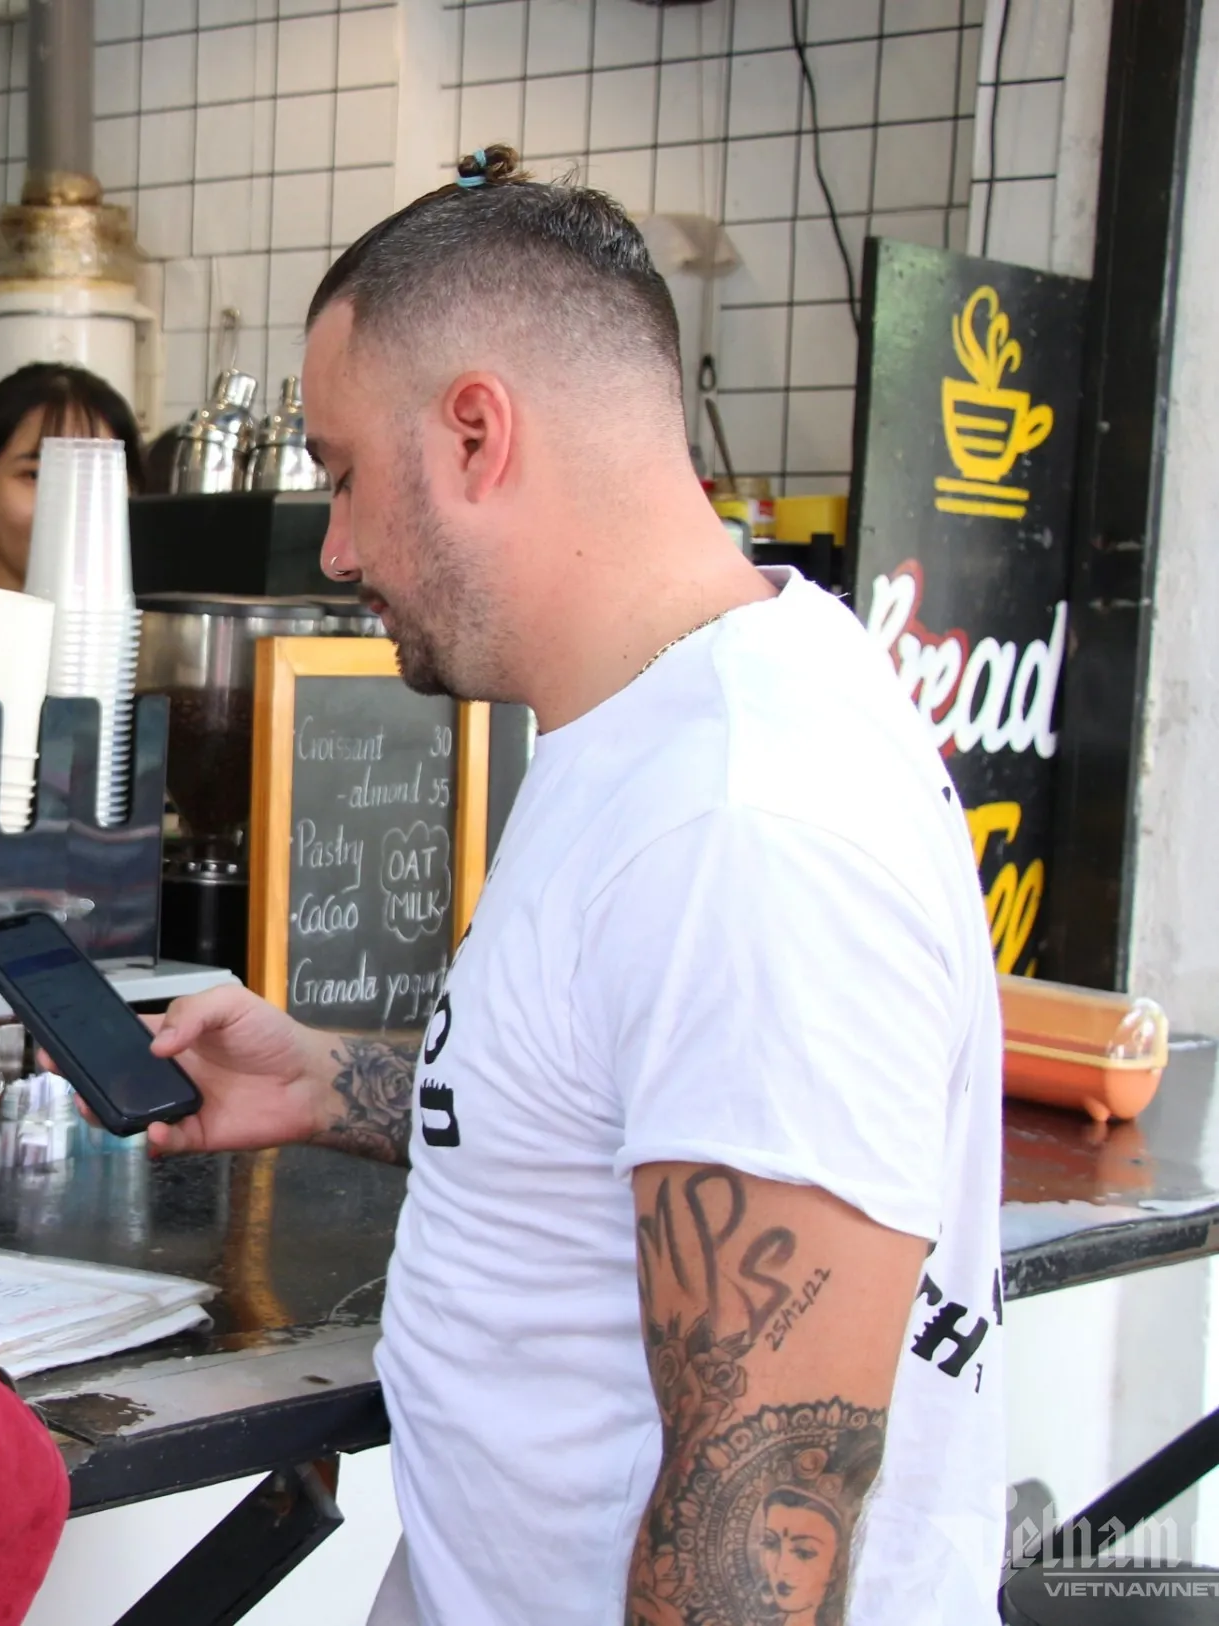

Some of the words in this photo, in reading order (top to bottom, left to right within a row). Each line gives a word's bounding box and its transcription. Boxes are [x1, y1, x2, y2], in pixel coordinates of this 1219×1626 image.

[298, 715, 385, 761] Croissant
[429, 724, 452, 757] 30
[297, 818, 364, 893] Pastry
[388, 847, 437, 881] OAT
[765, 1267, 832, 1352] 25/12/22
